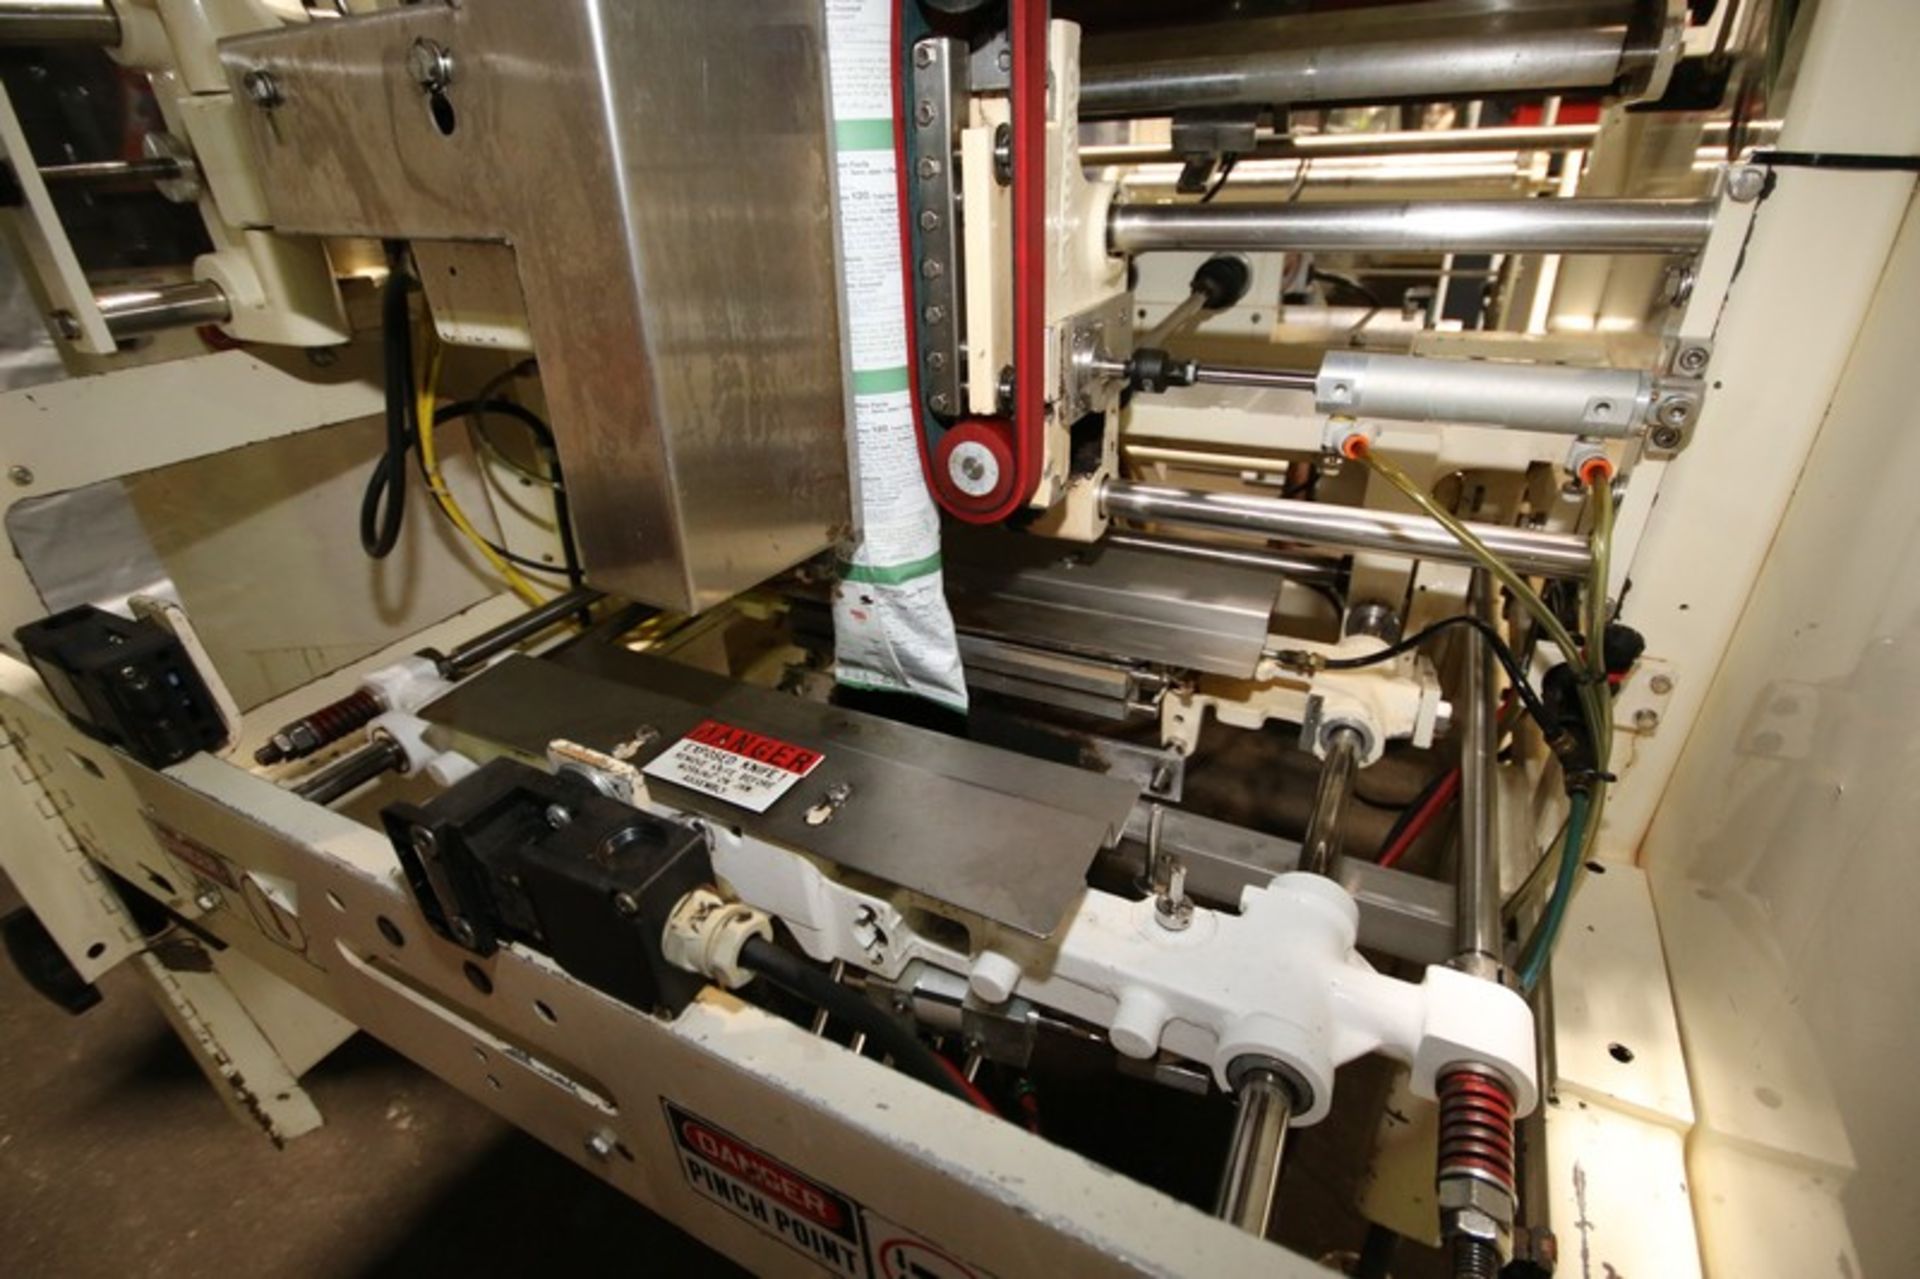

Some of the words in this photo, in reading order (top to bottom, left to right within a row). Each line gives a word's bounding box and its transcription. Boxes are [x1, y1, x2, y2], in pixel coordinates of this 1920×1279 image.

[688, 721, 816, 774] DANGER
[687, 1157, 769, 1224] PINCH
[773, 1209, 858, 1276] POINT
[698, 1132, 828, 1219] DANGER
